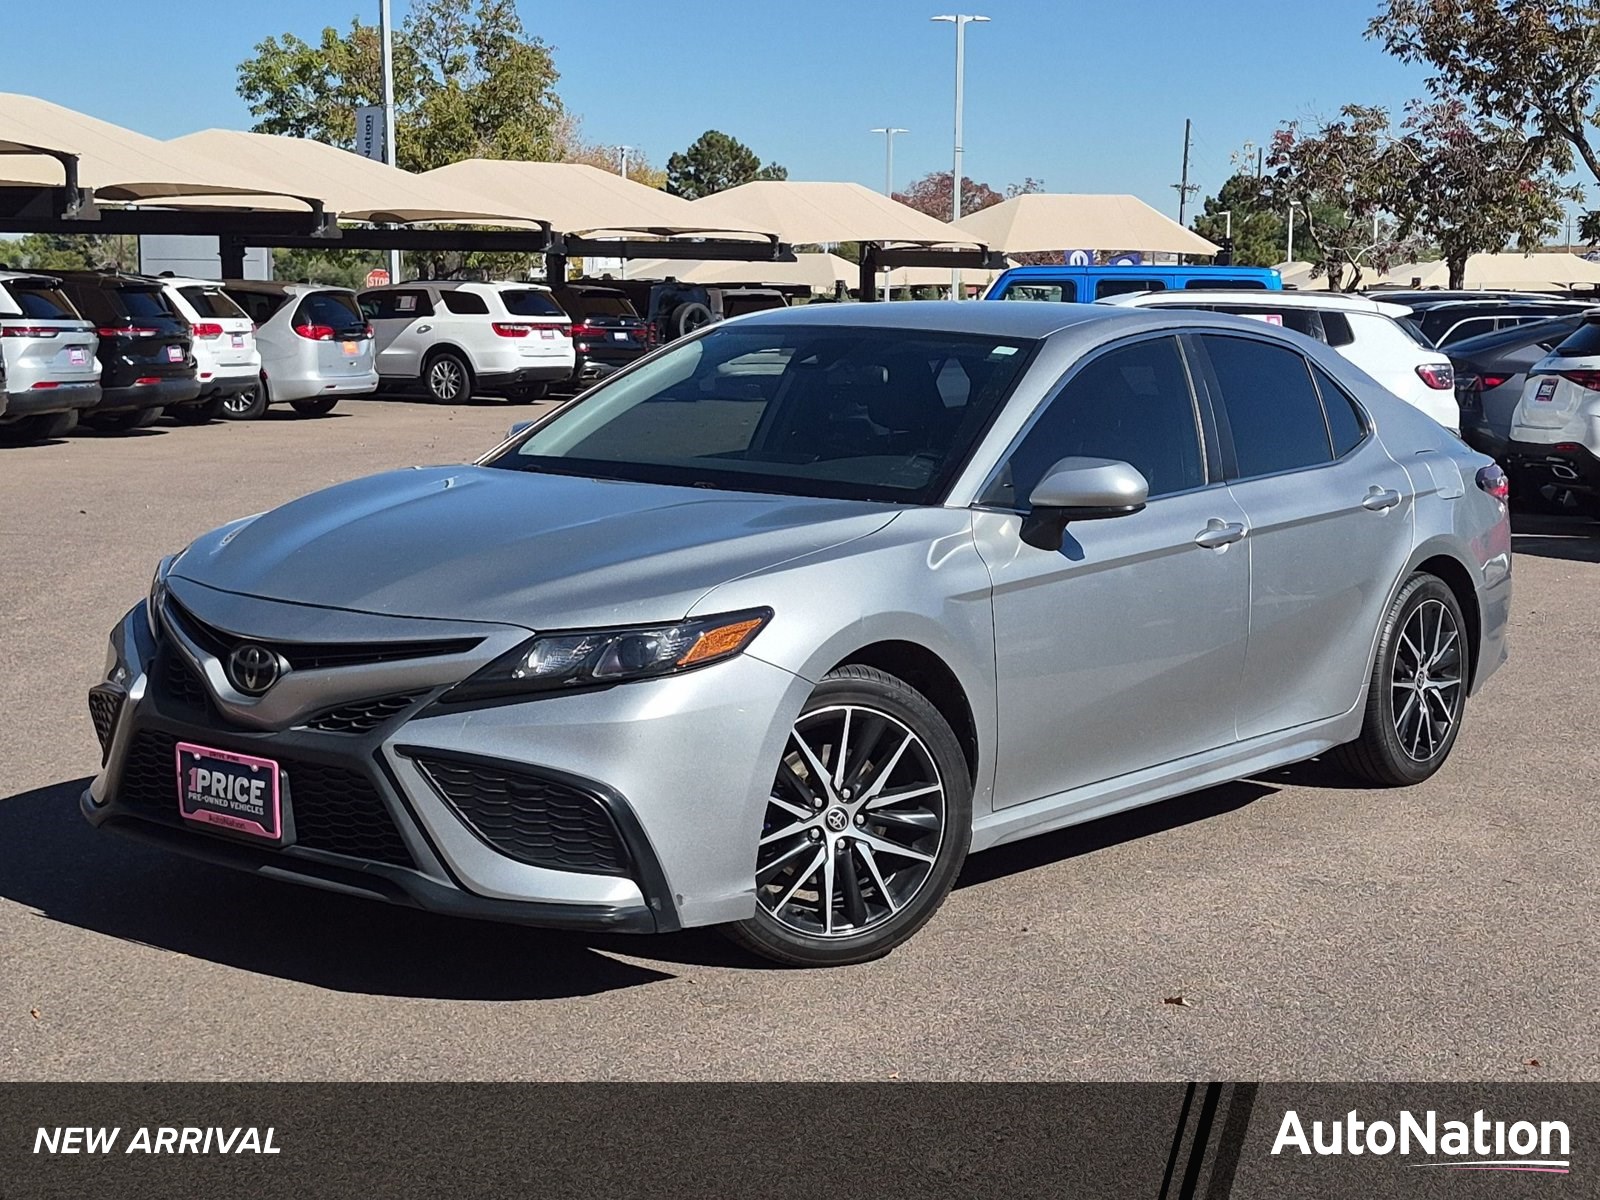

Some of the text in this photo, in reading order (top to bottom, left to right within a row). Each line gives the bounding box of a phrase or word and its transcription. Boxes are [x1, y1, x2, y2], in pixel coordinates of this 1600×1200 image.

[369, 276, 390, 287] STOP
[188, 791, 264, 816] PRE-OWNED VEHICLES
